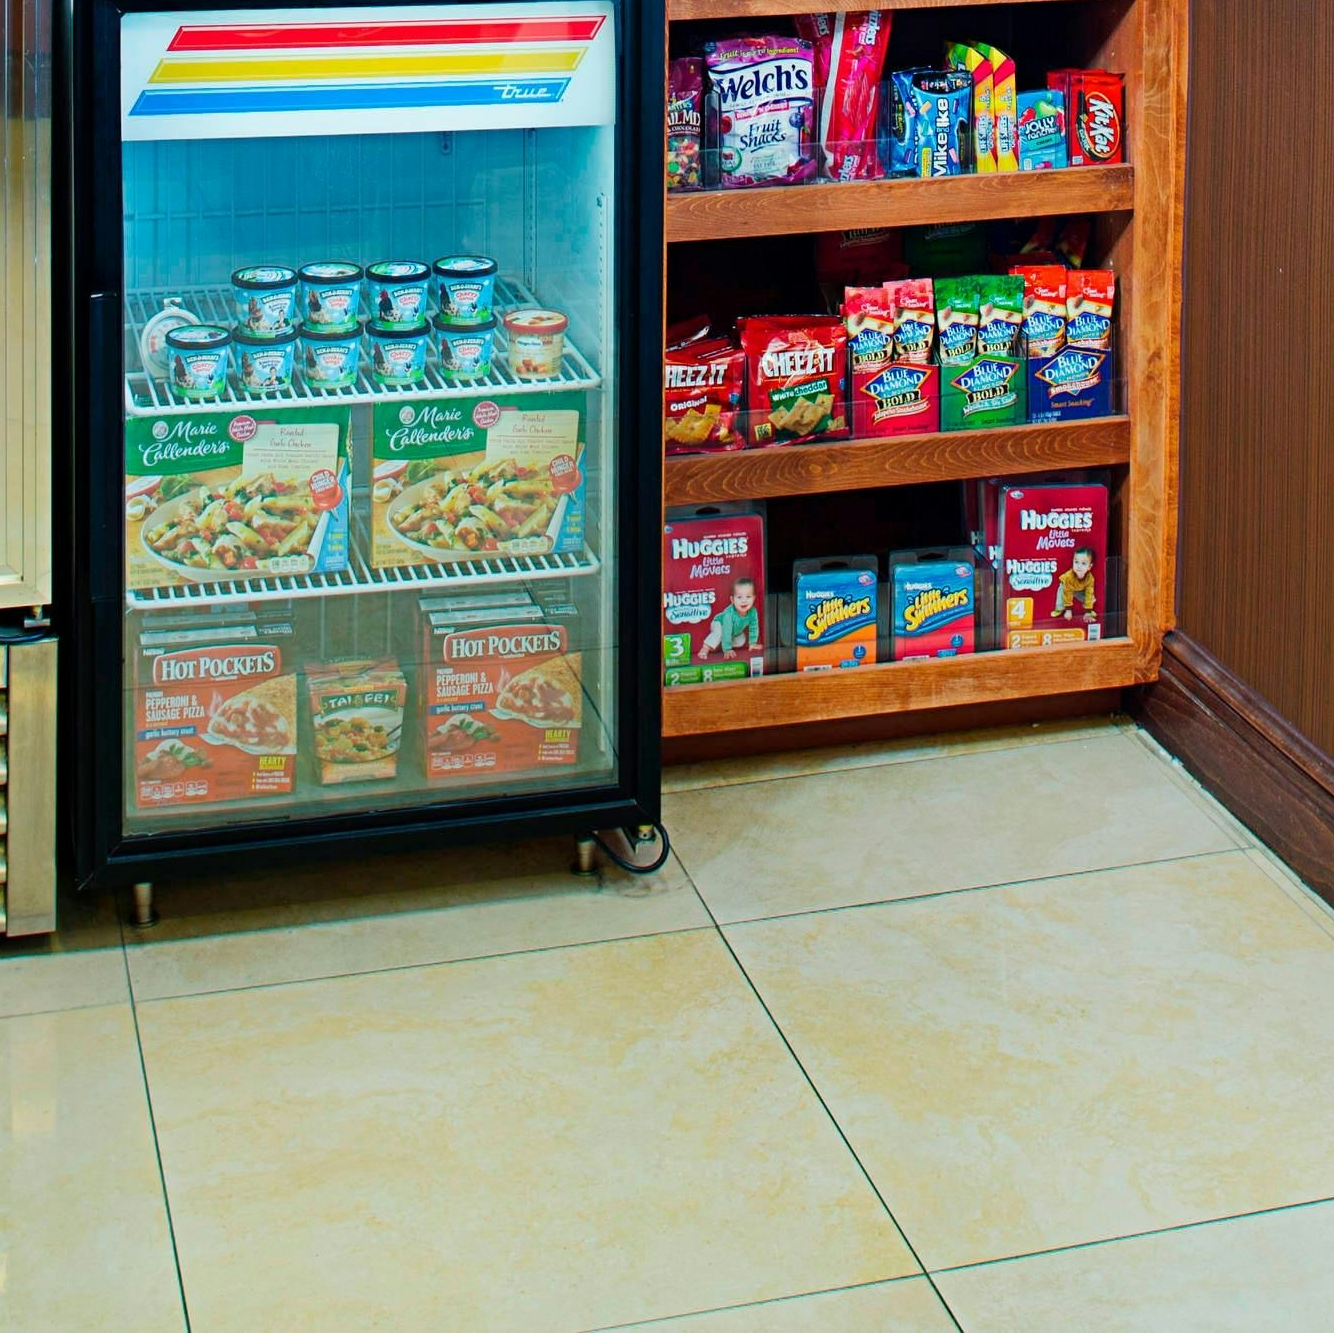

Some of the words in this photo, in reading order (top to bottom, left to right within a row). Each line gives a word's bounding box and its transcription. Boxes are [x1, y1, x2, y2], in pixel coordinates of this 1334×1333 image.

[492, 82, 555, 99] true
[717, 64, 809, 104] Welch's
[936, 98, 950, 127] Ike
[1088, 97, 1114, 126] Kit
[749, 118, 782, 134] Fruit
[1025, 115, 1055, 134] JOLLY
[739, 132, 787, 151] Snacks
[1088, 122, 1115, 153] Kat
[933, 132, 949, 177] Mike
[986, 321, 1006, 332] BLUE
[1027, 313, 1052, 325] BLUE
[1067, 319, 1110, 337] DIAMOND
[1074, 313, 1097, 325] BLUE
[858, 331, 881, 343] BLUE
[939, 327, 977, 345] DIAMOND
[945, 326, 965, 337] BLUE
[978, 325, 1018, 339] DIAMOND
[849, 335, 891, 354] DIAMOND
[948, 343, 971, 356] BOLD
[986, 341, 1011, 352] BOLD
[1045, 356, 1098, 379] DIAMOND
[1058, 351, 1083, 366] BLUE
[883, 367, 908, 383] BLUE
[960, 367, 1012, 388] DIAMOND
[973, 363, 998, 377] BLUE
[870, 372, 924, 396] DIAMOND
[883, 392, 916, 408] BOLD
[972, 385, 1005, 403] BOLD
[419, 405, 463, 429] Marie
[172, 420, 218, 443] Marie
[387, 426, 475, 451] Callender's
[141, 440, 229, 467] Callender's
[1020, 509, 1093, 531] HUGGIES
[1036, 537, 1076, 550] Movers
[1048, 530, 1070, 539] Little
[671, 536, 749, 560] HUGGIES
[702, 556, 724, 566] Little
[1007, 559, 1058, 574] HUGGIES
[690, 564, 731, 579] Movers
[664, 591, 716, 608] HUGGIES
[816, 596, 844, 618] Little
[914, 589, 941, 610] Little
[904, 588, 968, 632] Swimmers
[1011, 600, 1026, 619] 4
[805, 597, 871, 641] Swimmers
[450, 636, 486, 659] HOT
[488, 630, 562, 655] POCKETS
[670, 637, 684, 657] 3
[1042, 633, 1053, 645] 8
[161, 657, 198, 682] HOT
[199, 650, 275, 678] POCKETS
[436, 673, 480, 687] PEPPERONI
[703, 669, 713, 682] 8
[436, 683, 472, 697] SAUSAGE
[472, 682, 495, 695] PIZZA
[145, 694, 189, 711] PEPPERONI
[329, 695, 352, 708] TAI
[364, 692, 389, 705] PEI
[145, 708, 181, 722] SAUSAGE
[183, 705, 206, 719] PIZZA
